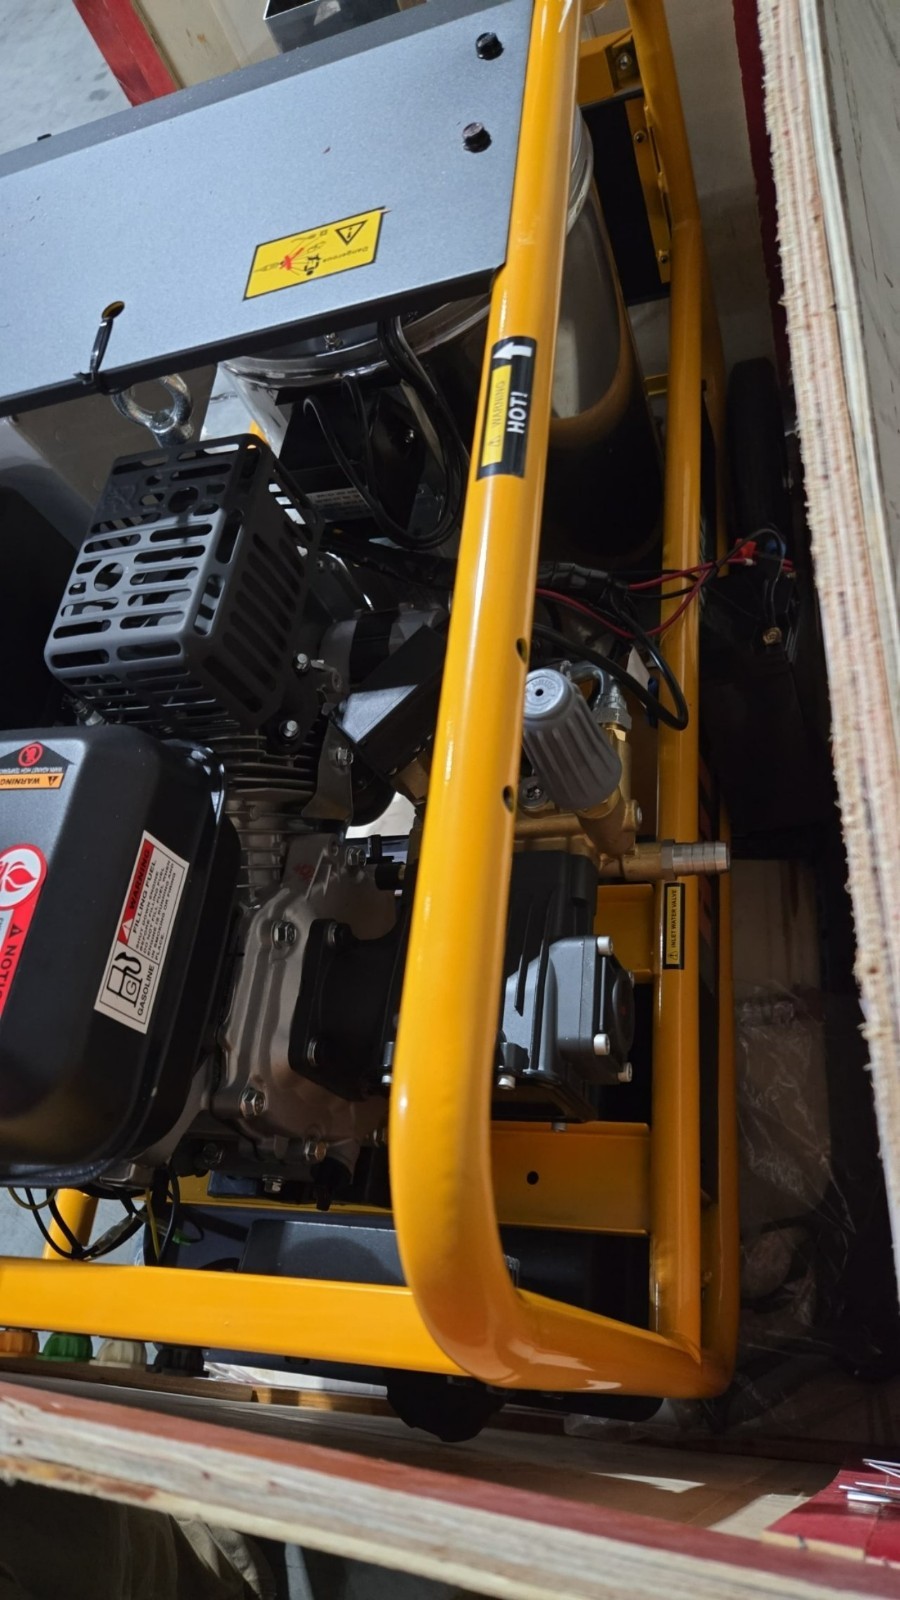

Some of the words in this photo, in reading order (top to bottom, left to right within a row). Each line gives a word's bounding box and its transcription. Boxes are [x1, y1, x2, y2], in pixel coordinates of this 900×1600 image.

[492, 381, 505, 425] WARNING
[507, 391, 528, 434] HOT!
[130, 849, 150, 909] WARNING
[141, 901, 151, 925] DOWN
[149, 871, 159, 899] ENGINE
[133, 890, 147, 933] FILLING
[139, 919, 150, 951] BEFORE
[147, 888, 158, 917] FILLING
[144, 943, 149, 954] DO
[156, 885, 164, 903] FUEL
[147, 926, 157, 956] ENGINE
[157, 881, 169, 914] RUNNING
[154, 913, 165, 948] SMOKING
[137, 965, 155, 1016] GASOLINE
